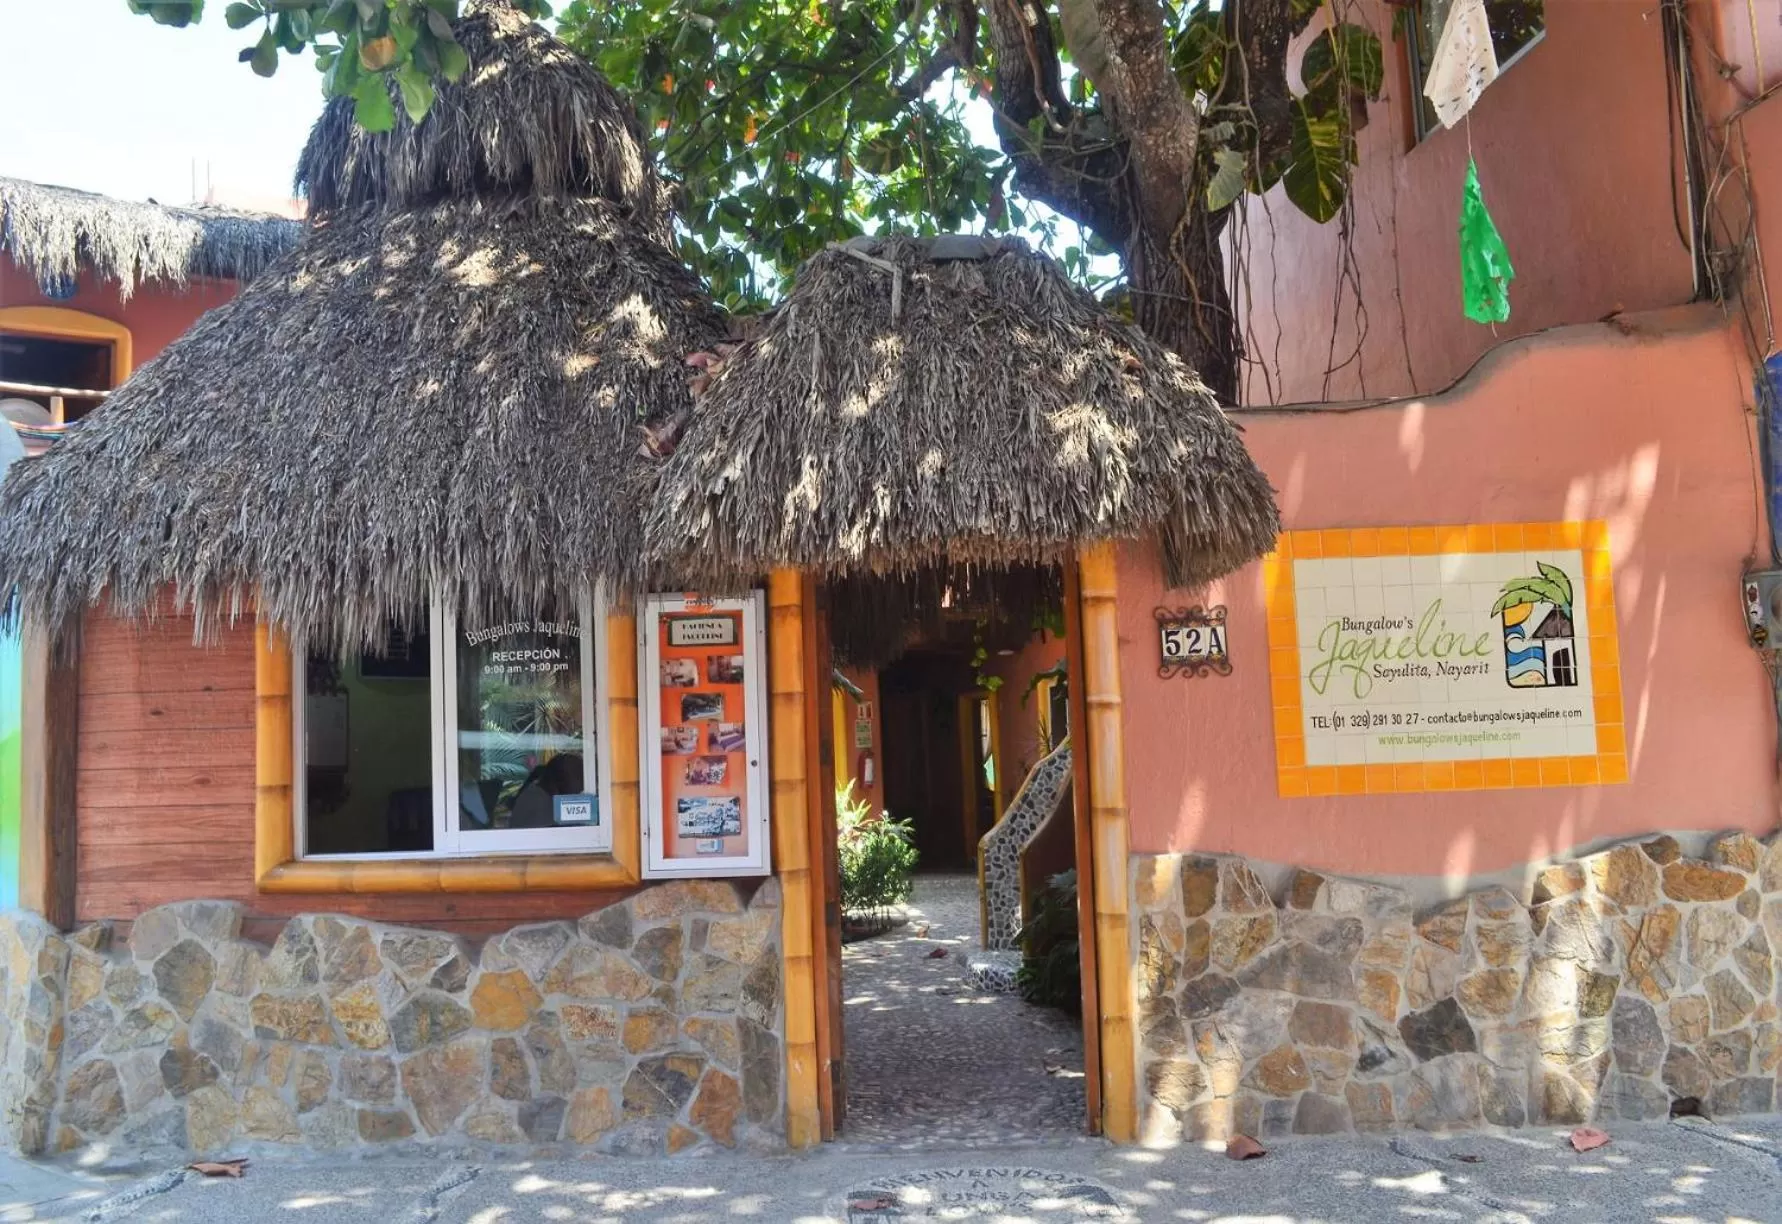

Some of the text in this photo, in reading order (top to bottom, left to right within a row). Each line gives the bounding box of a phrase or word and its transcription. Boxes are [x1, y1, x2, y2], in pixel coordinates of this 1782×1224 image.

[465, 619, 530, 646] Bungalows
[1341, 616, 1414, 635] Bungalow's
[1165, 627, 1224, 655] 52A
[1309, 598, 1494, 699] Jaqueline
[492, 648, 560, 662] RECEPCIÓN
[484, 664, 505, 675] 9:00
[507, 665, 522, 674] am
[530, 662, 551, 672] 9:00
[553, 662, 569, 673] pm
[1436, 661, 1489, 680] Nayarit
[1373, 713, 1388, 726] 291
[1392, 714, 1402, 725] 30
[566, 806, 587, 815] VISA
